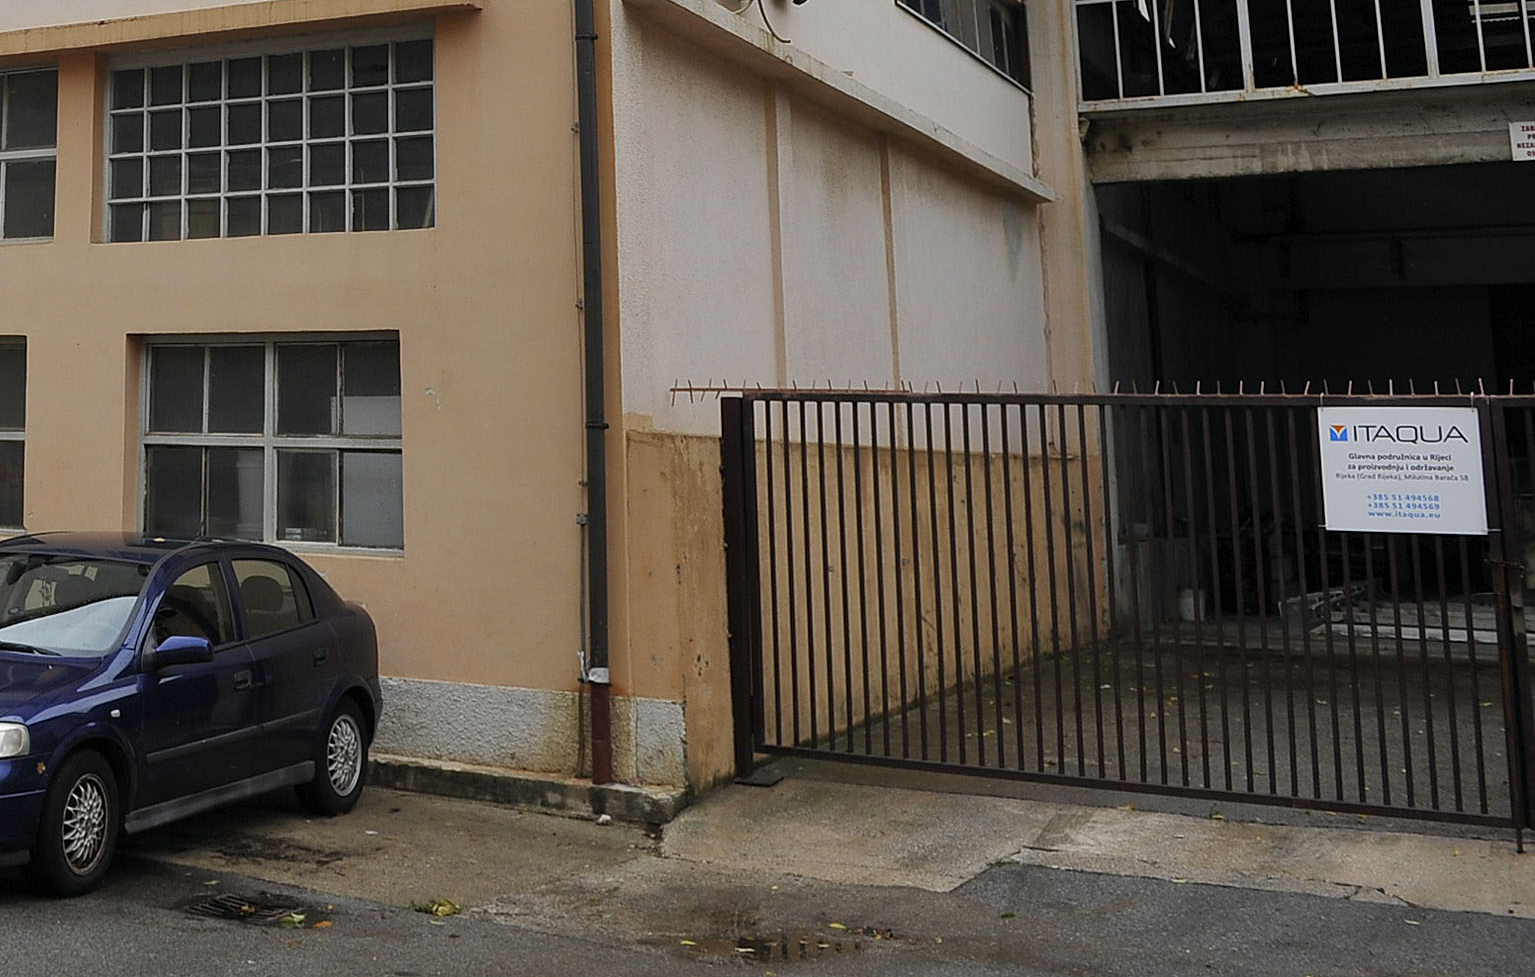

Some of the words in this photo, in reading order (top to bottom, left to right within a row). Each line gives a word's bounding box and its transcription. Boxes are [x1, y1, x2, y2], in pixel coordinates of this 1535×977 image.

[1353, 425, 1469, 445] ITAQUA
[1377, 453, 1421, 461] podružnica
[1429, 454, 1452, 462] Rijeci
[1358, 464, 1404, 472] proizvodnju
[1410, 464, 1454, 472] održavanje
[1368, 511, 1441, 519] www.itaqua.eu
